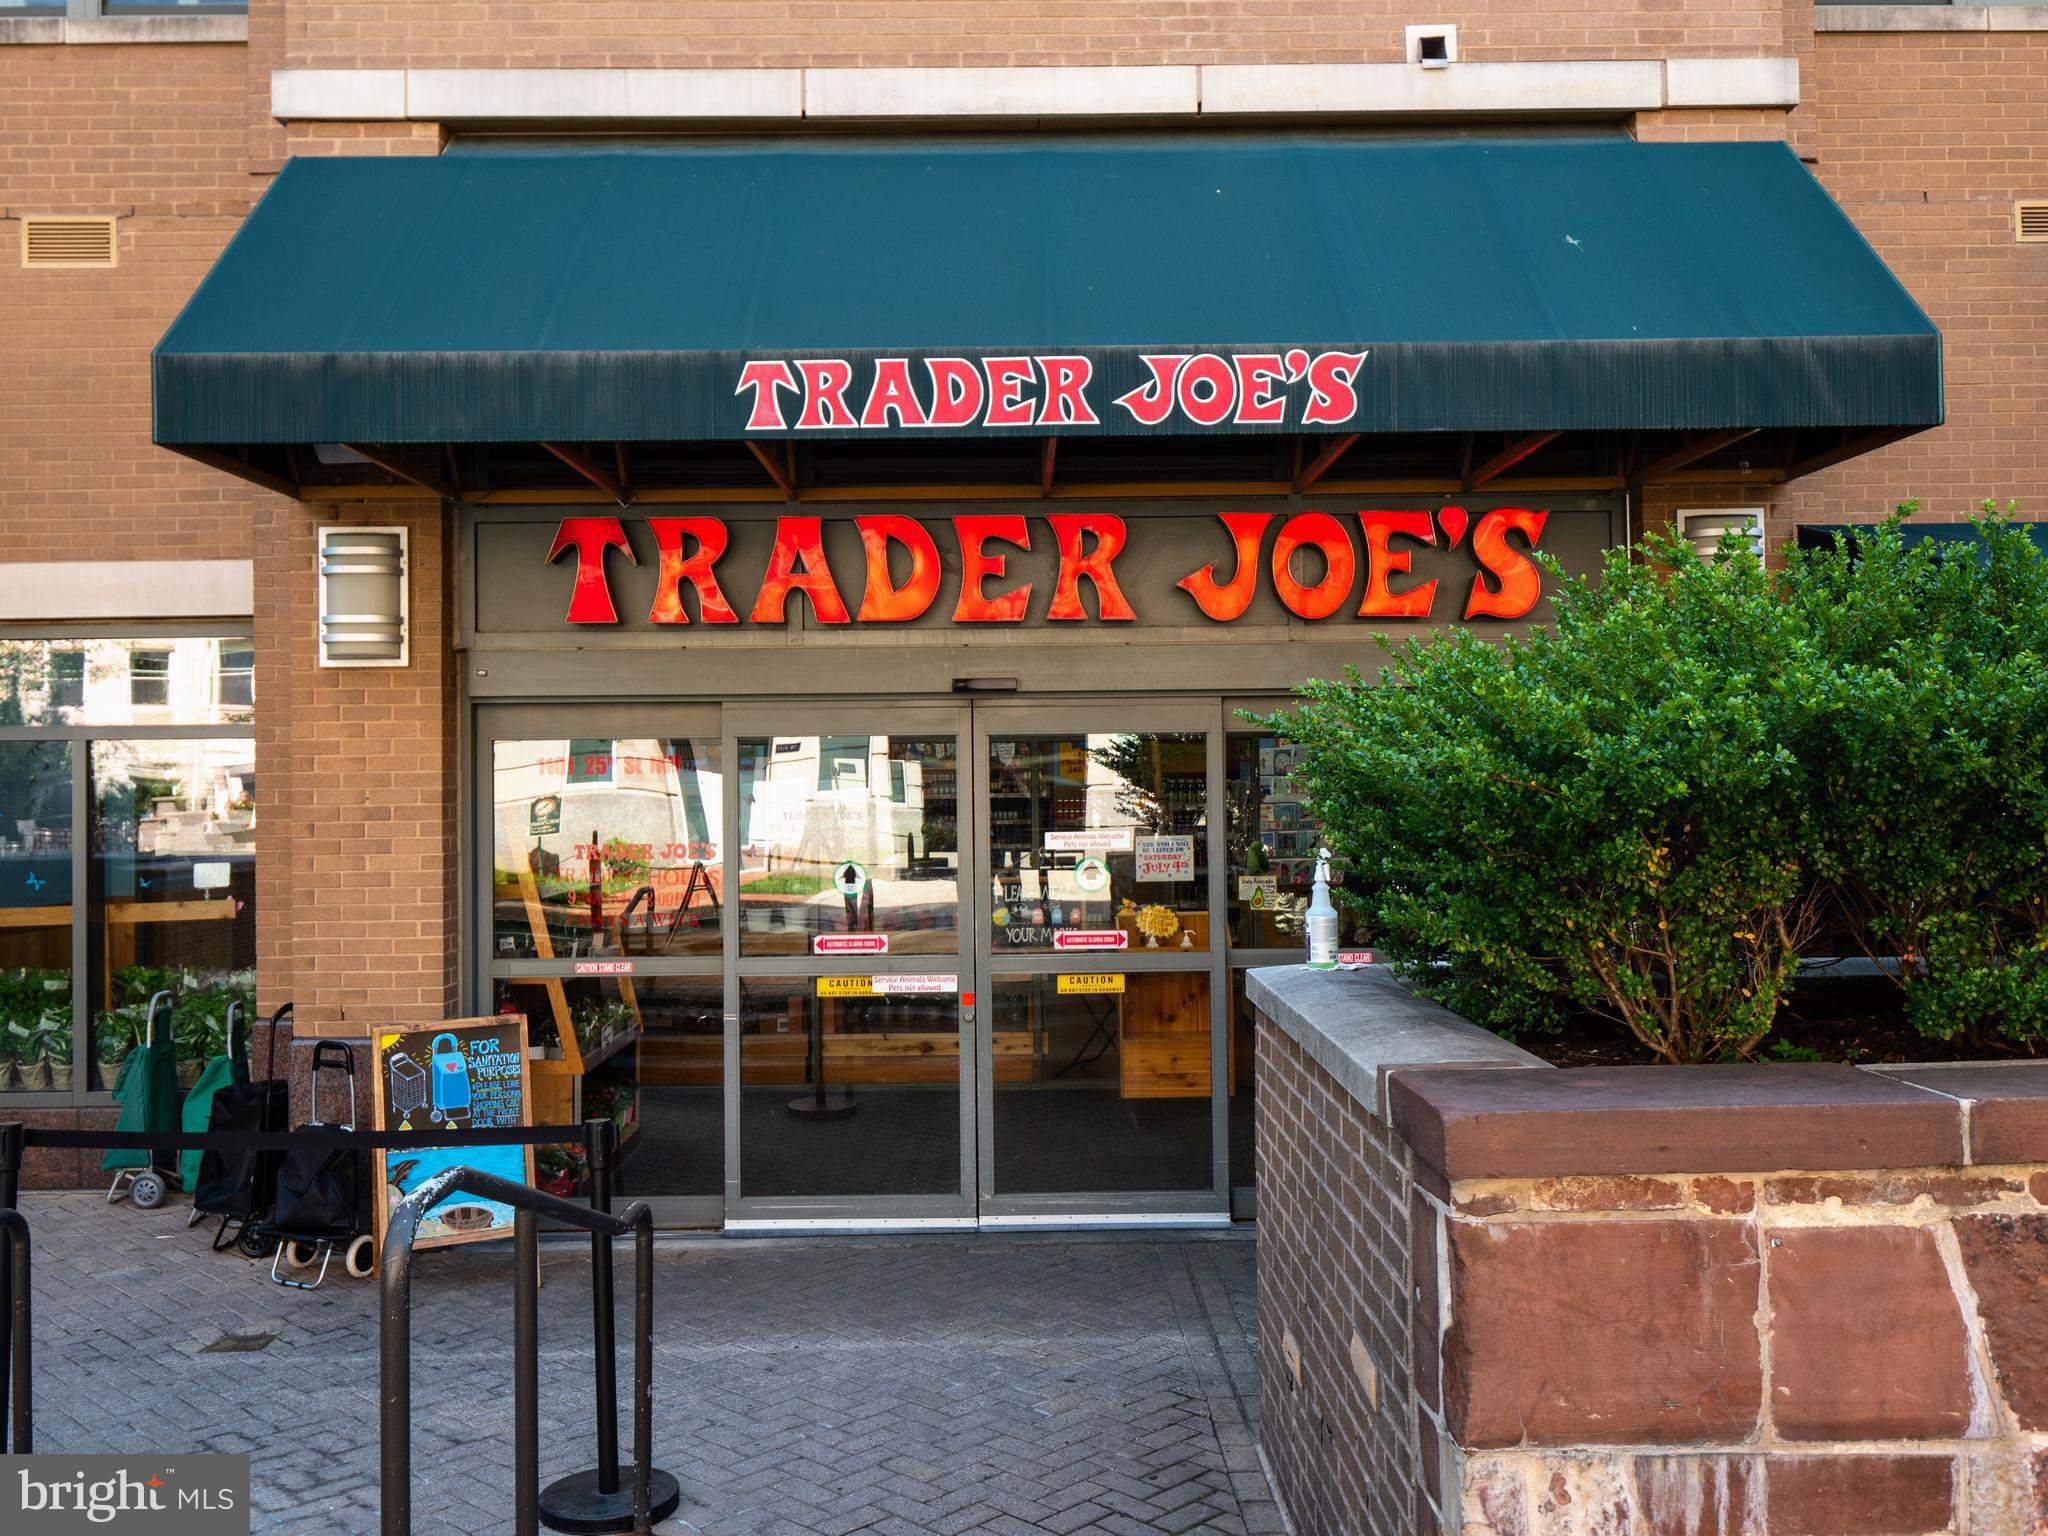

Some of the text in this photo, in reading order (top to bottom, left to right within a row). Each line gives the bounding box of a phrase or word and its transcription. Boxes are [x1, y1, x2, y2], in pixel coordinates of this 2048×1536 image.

[735, 349, 1369, 430] TRADER JOE'S
[545, 505, 1550, 624] TRADER JOE'S
[1063, 840, 1077, 848] Pets
[574, 842, 718, 860] TRADER JOE'S
[1143, 853, 1182, 861] SATURDAY
[1142, 861, 1171, 875] JULY
[633, 912, 646, 927] A
[650, 911, 703, 928] WEEK
[1006, 927, 1039, 943] YOUR
[1338, 953, 1353, 962] STAND
[577, 963, 598, 972] CAUTION
[599, 963, 614, 972] STAND
[829, 979, 873, 988] CAUTION
[1069, 975, 1114, 985] CAUTION
[469, 1037, 500, 1056] FOR
[468, 1051, 520, 1069] SANITATION
[476, 1064, 521, 1078] PURPOSES
[472, 1091, 488, 1100] YOUR
[472, 1097, 520, 1110] SHOPPING CART
[472, 1106, 520, 1119] AT THE FRONT
[471, 1115, 517, 1127] DOOR WITH
